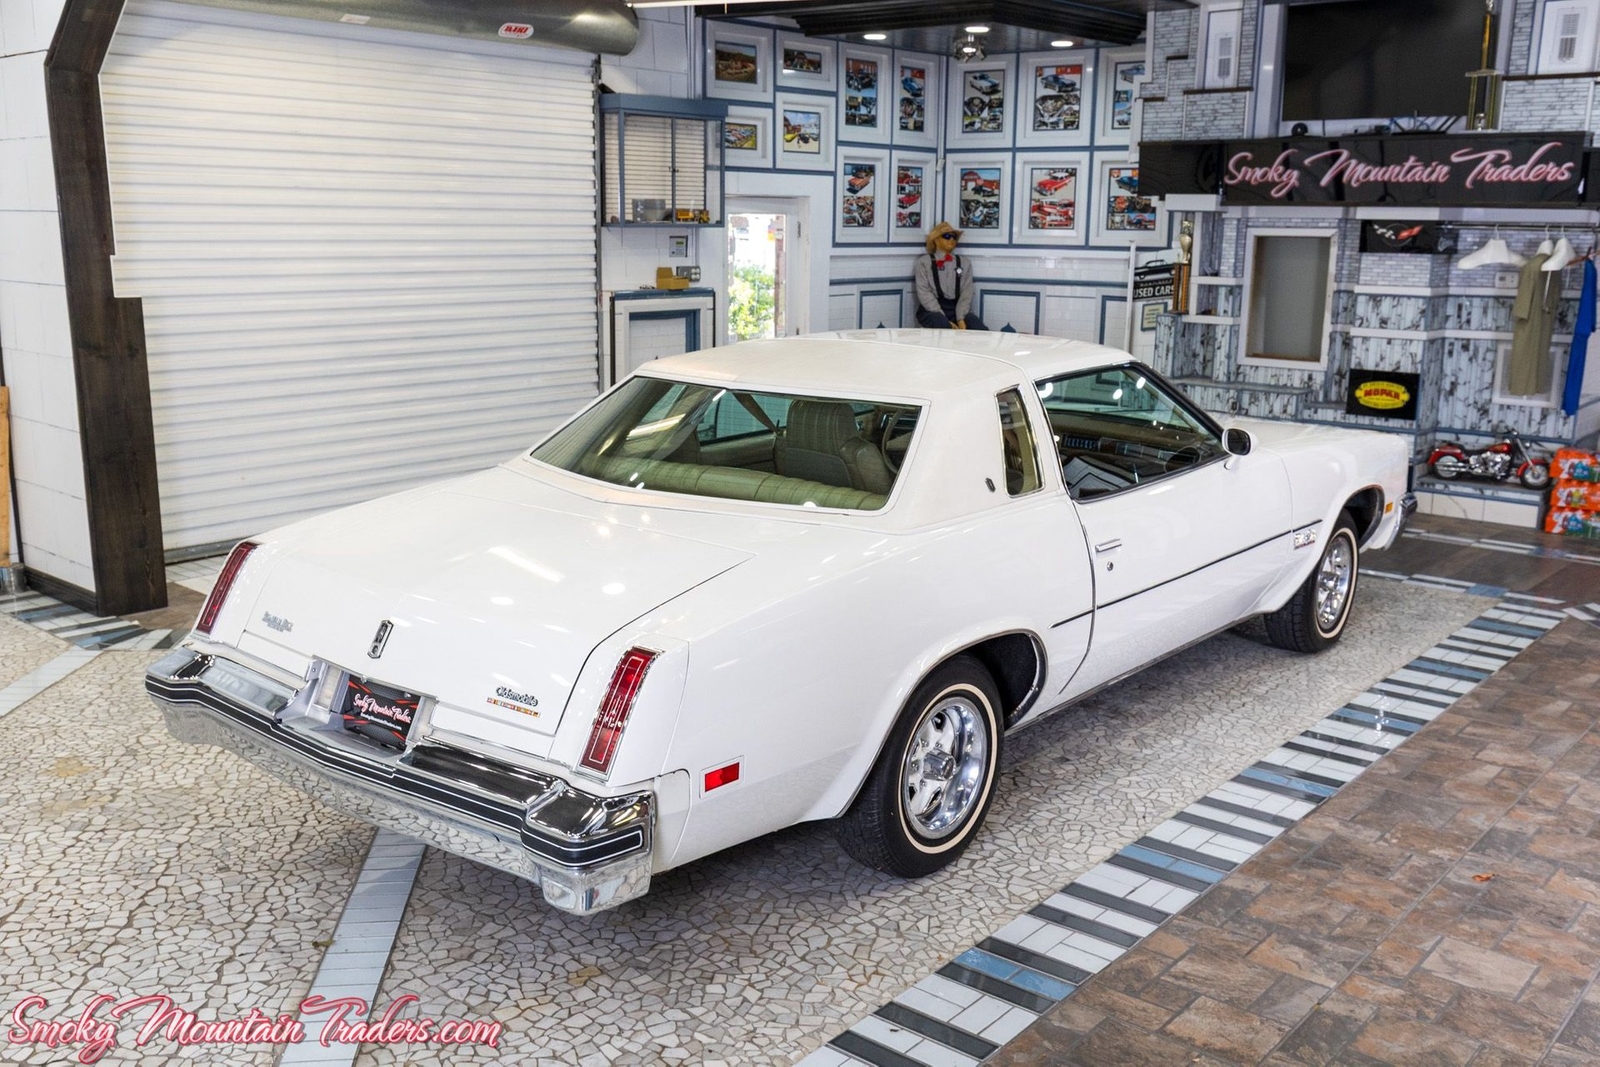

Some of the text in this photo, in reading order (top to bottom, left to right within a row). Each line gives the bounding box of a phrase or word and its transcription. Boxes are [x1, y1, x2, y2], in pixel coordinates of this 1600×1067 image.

[1224, 141, 1575, 198] Smoky Mountain Traders
[1133, 287, 1154, 298] USED
[1363, 388, 1401, 400] MOPAR
[495, 686, 539, 707] Oldsmobile
